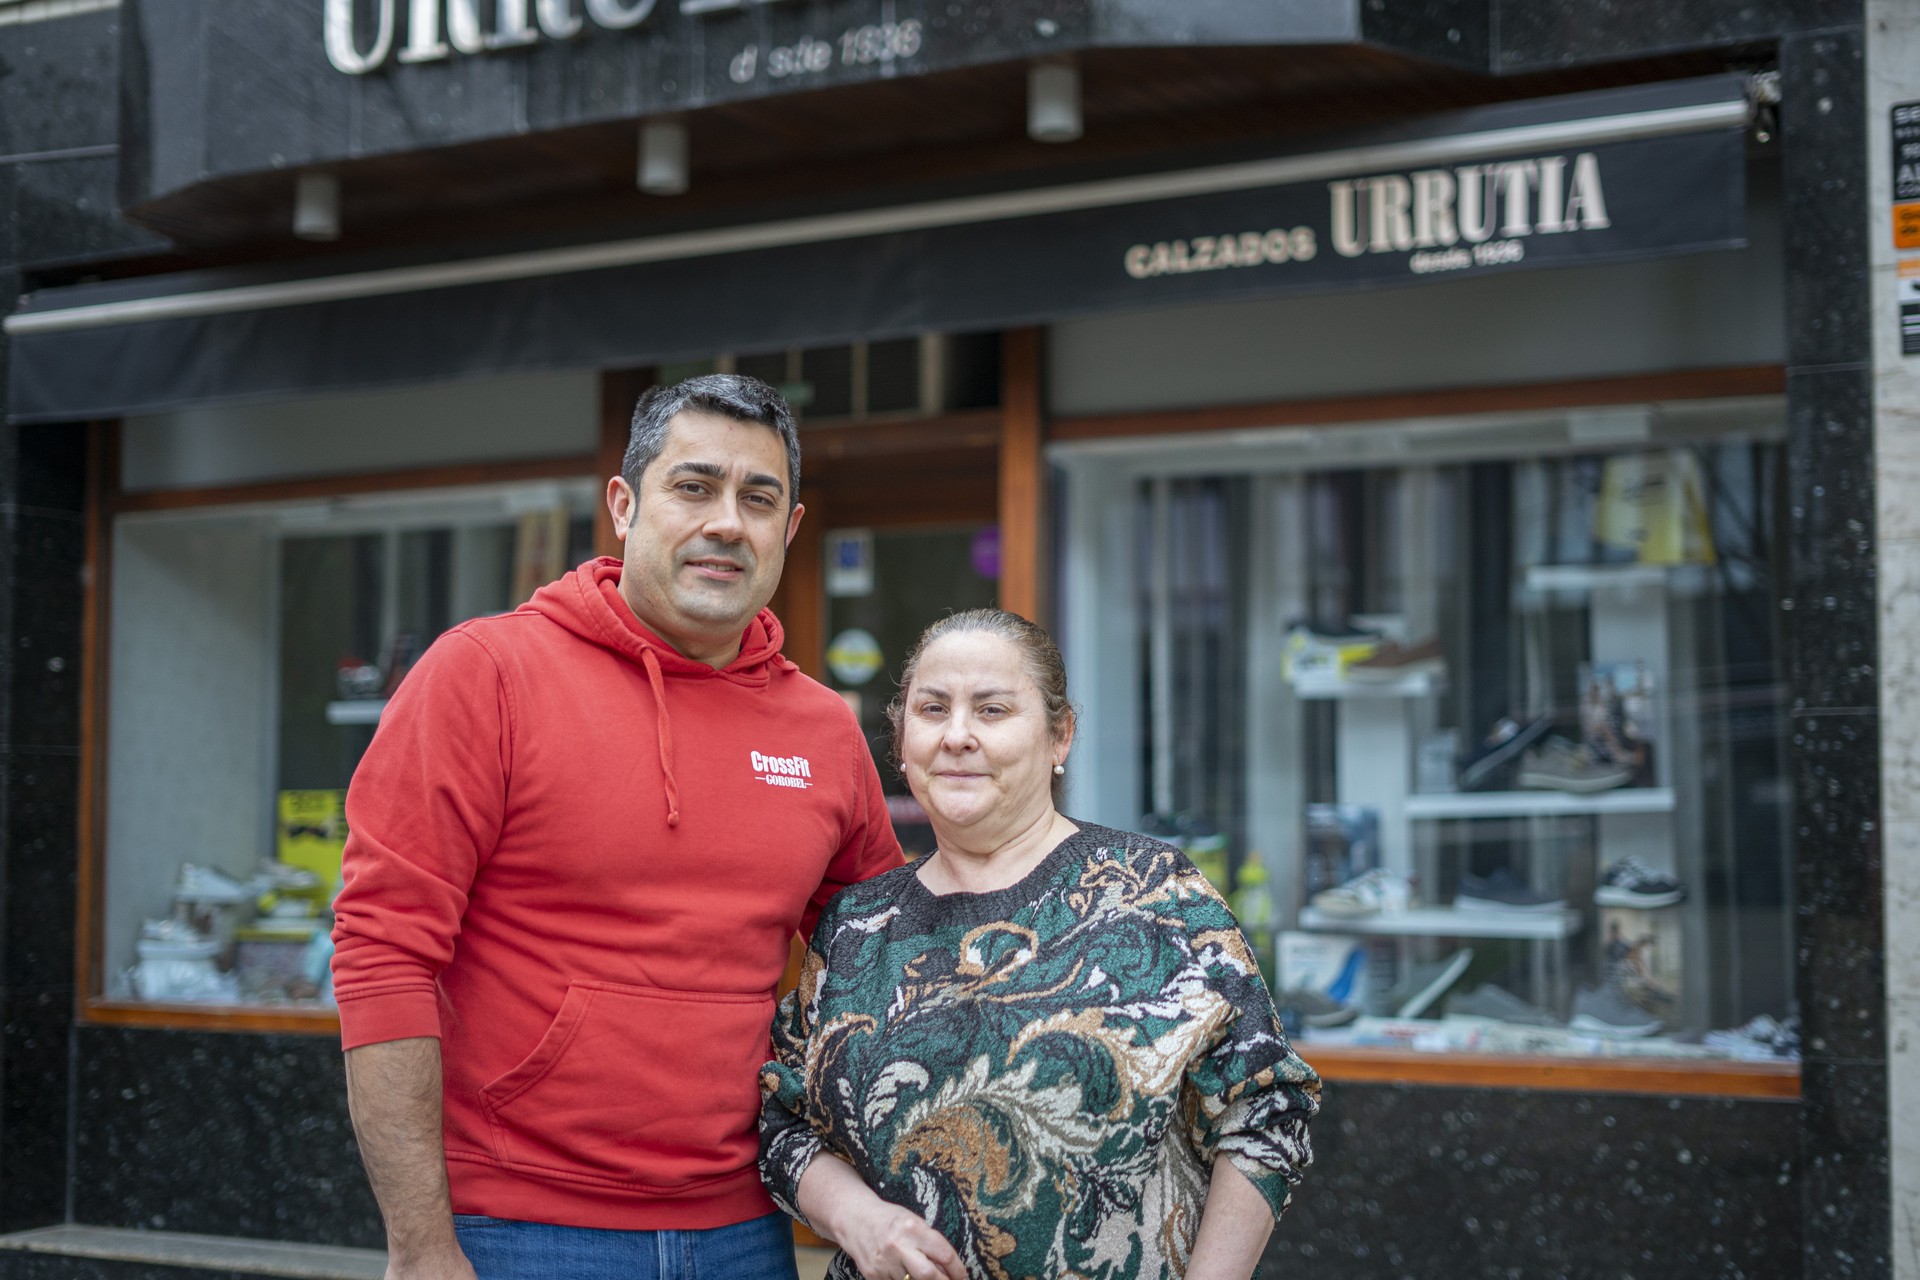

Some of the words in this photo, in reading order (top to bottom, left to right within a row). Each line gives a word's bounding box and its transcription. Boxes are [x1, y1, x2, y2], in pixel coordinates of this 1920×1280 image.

[1328, 152, 1611, 257] URRUTIA
[1125, 227, 1317, 279] CALZADOS
[1409, 247, 1472, 274] desde
[750, 750, 812, 778] CrossFit
